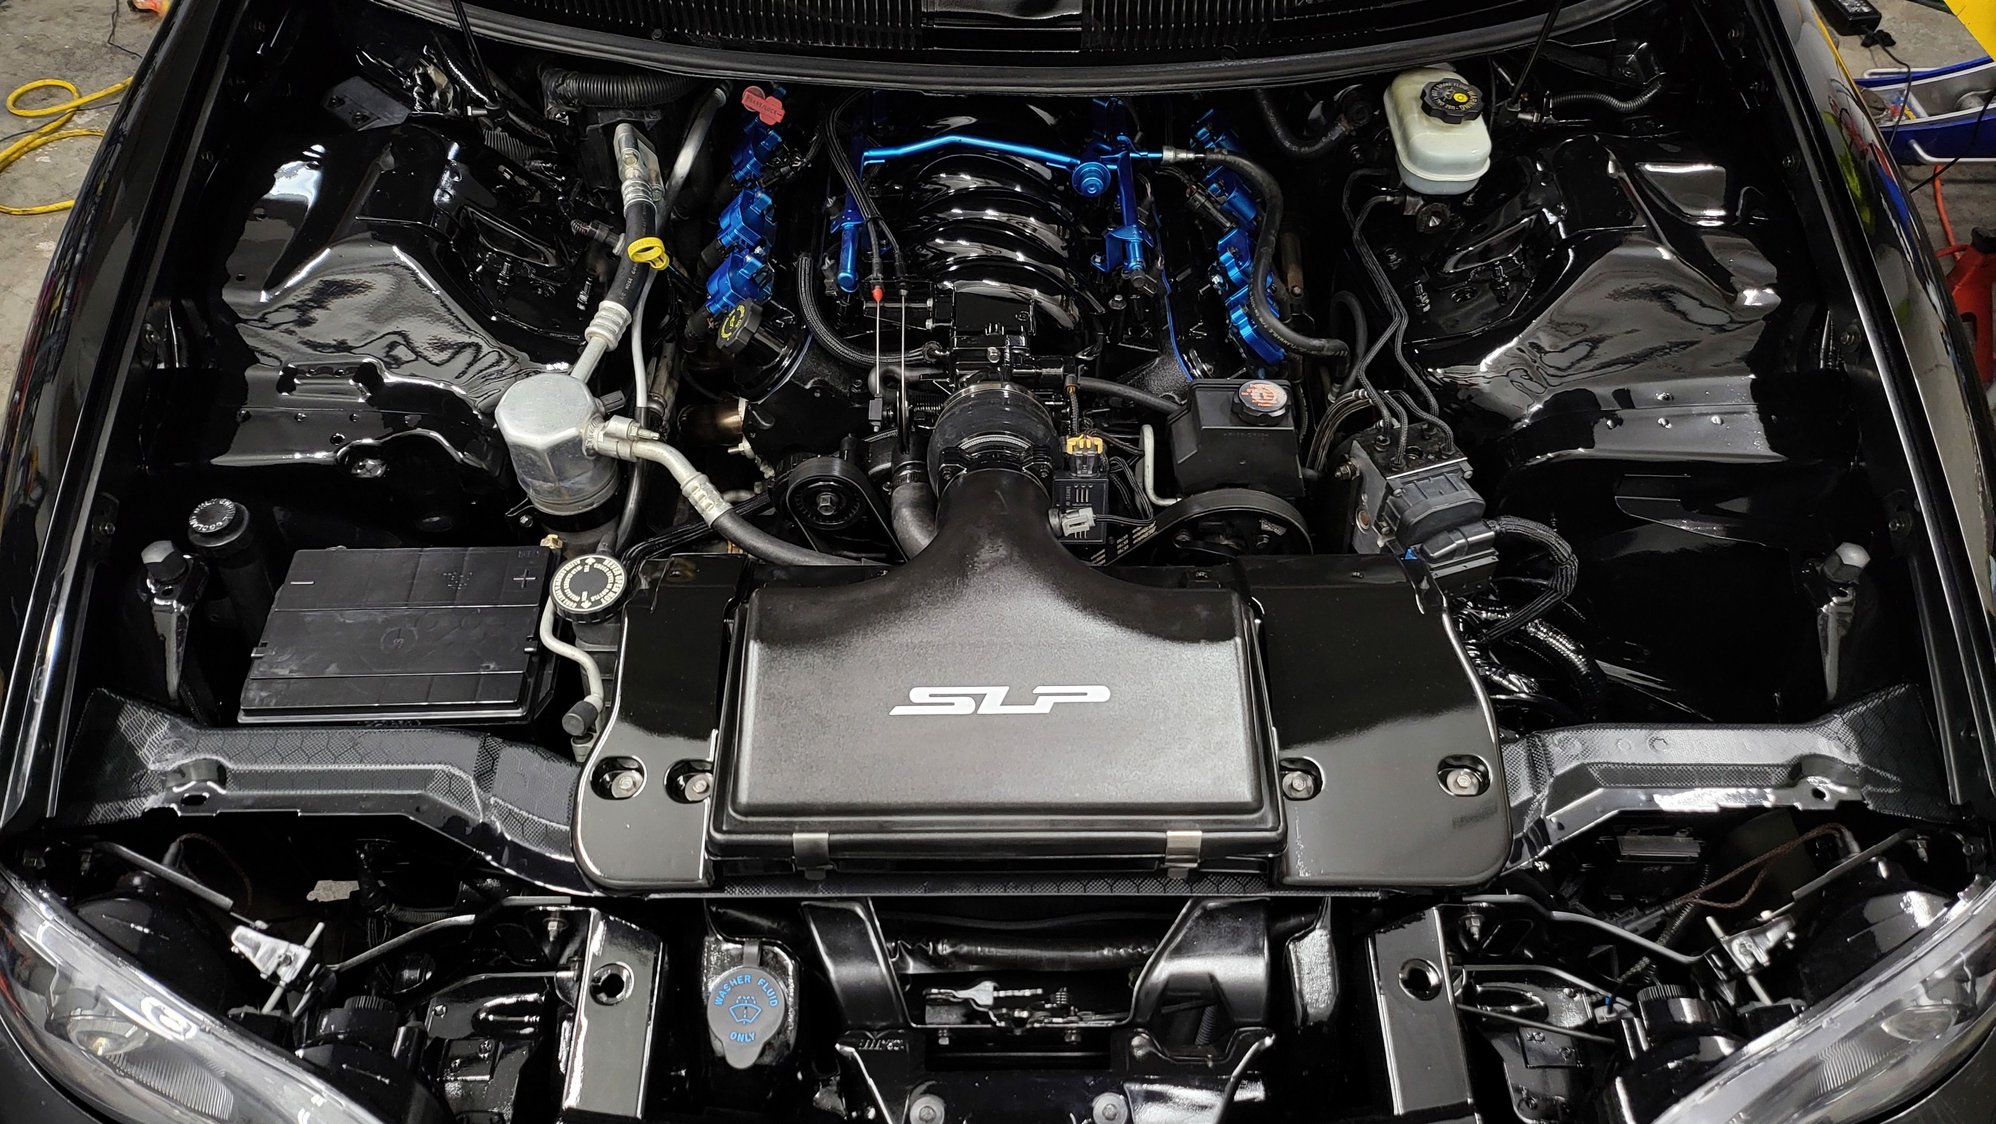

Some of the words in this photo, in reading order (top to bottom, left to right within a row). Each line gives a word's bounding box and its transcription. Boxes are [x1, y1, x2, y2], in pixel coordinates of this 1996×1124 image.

[888, 685, 1111, 715] SLP
[714, 974, 752, 1006] WASHER
[757, 977, 779, 1007] FLUID
[729, 1031, 756, 1042] ONLY
